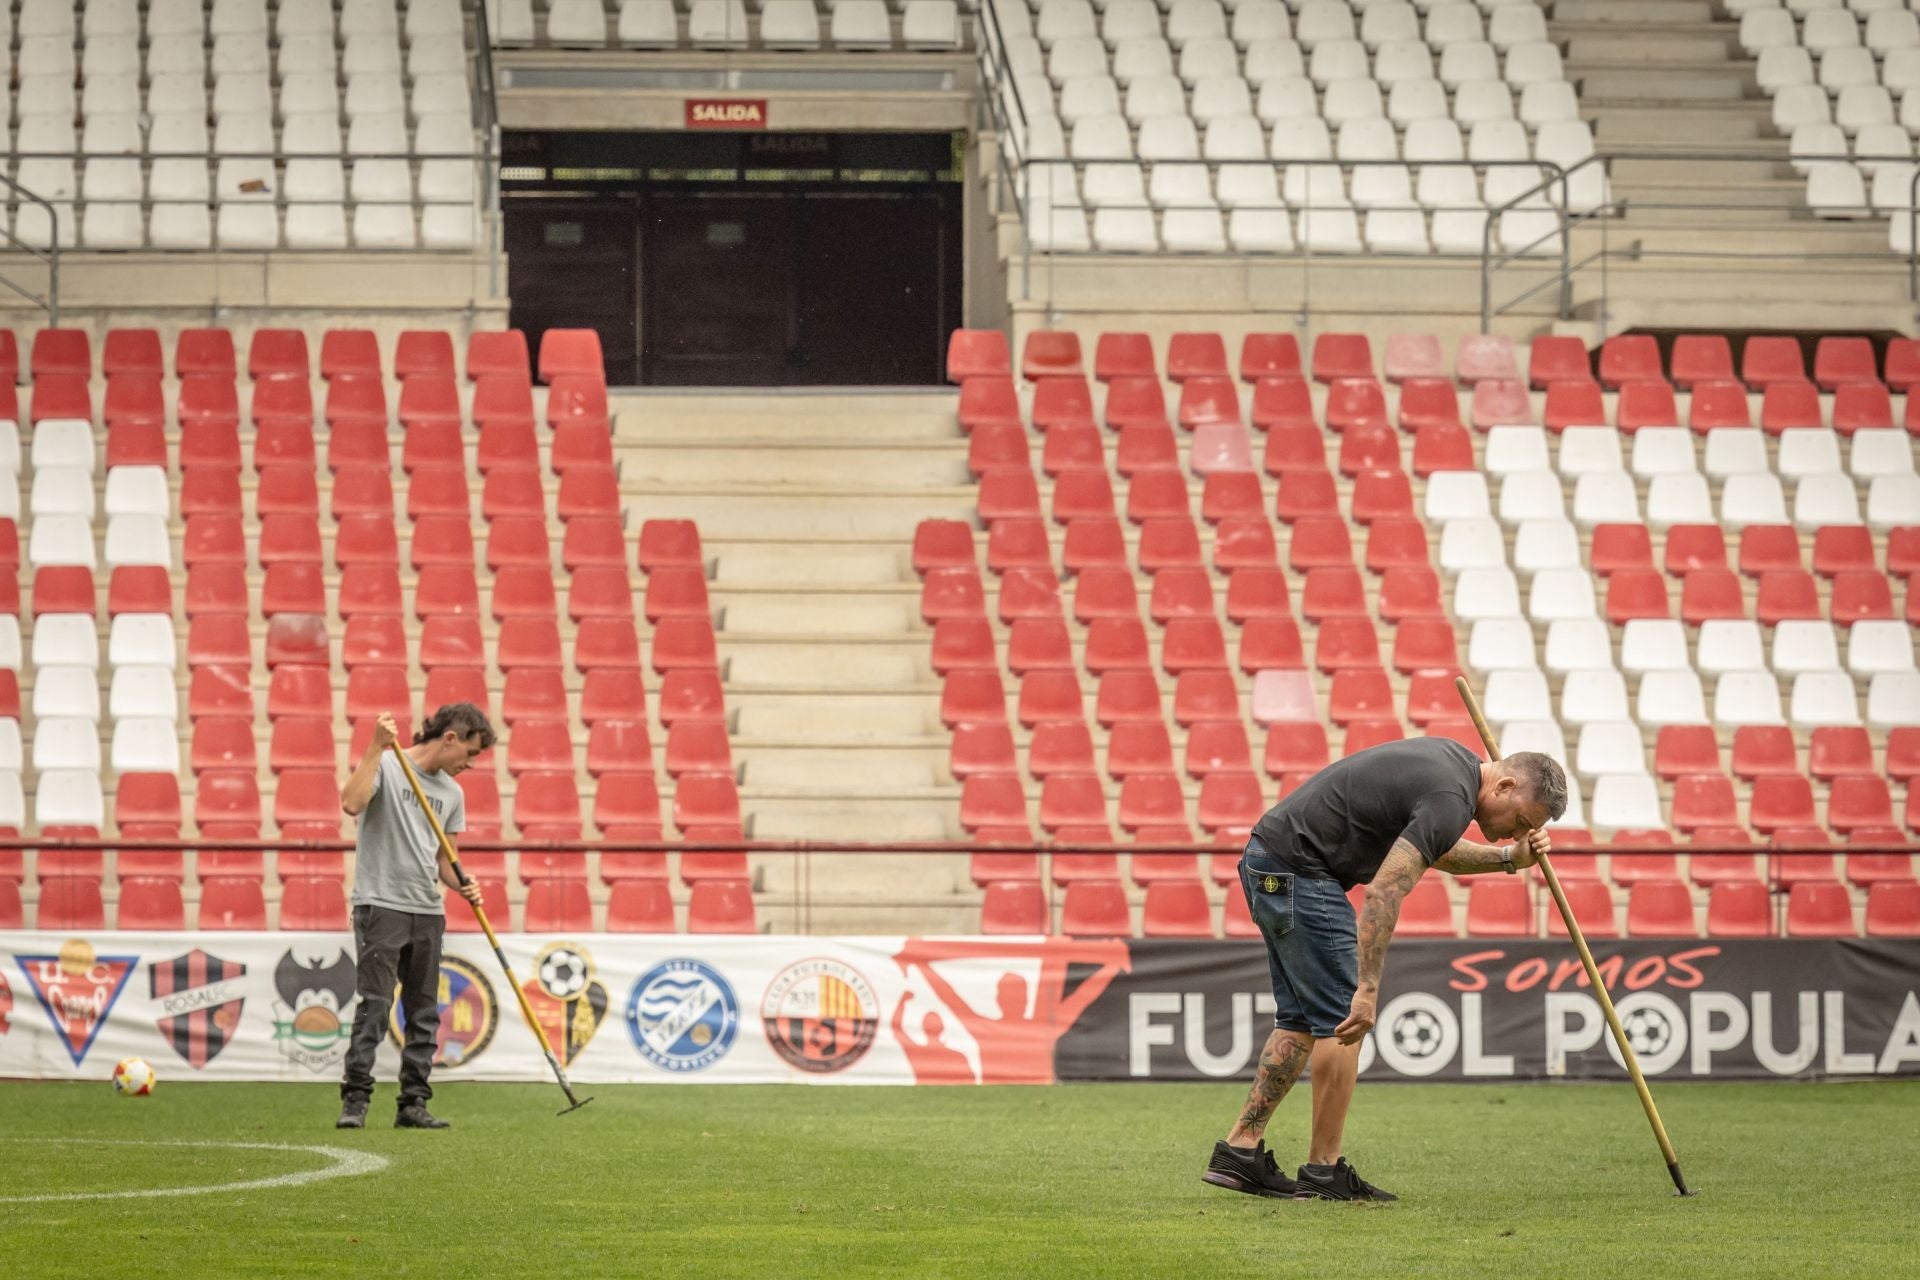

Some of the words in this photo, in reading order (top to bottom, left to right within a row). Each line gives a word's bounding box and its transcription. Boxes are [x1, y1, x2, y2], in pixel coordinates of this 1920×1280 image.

[692, 104, 761, 121] SALIDA
[751, 136, 829, 153] SALIDA
[1129, 992, 1514, 1076] FUOL
